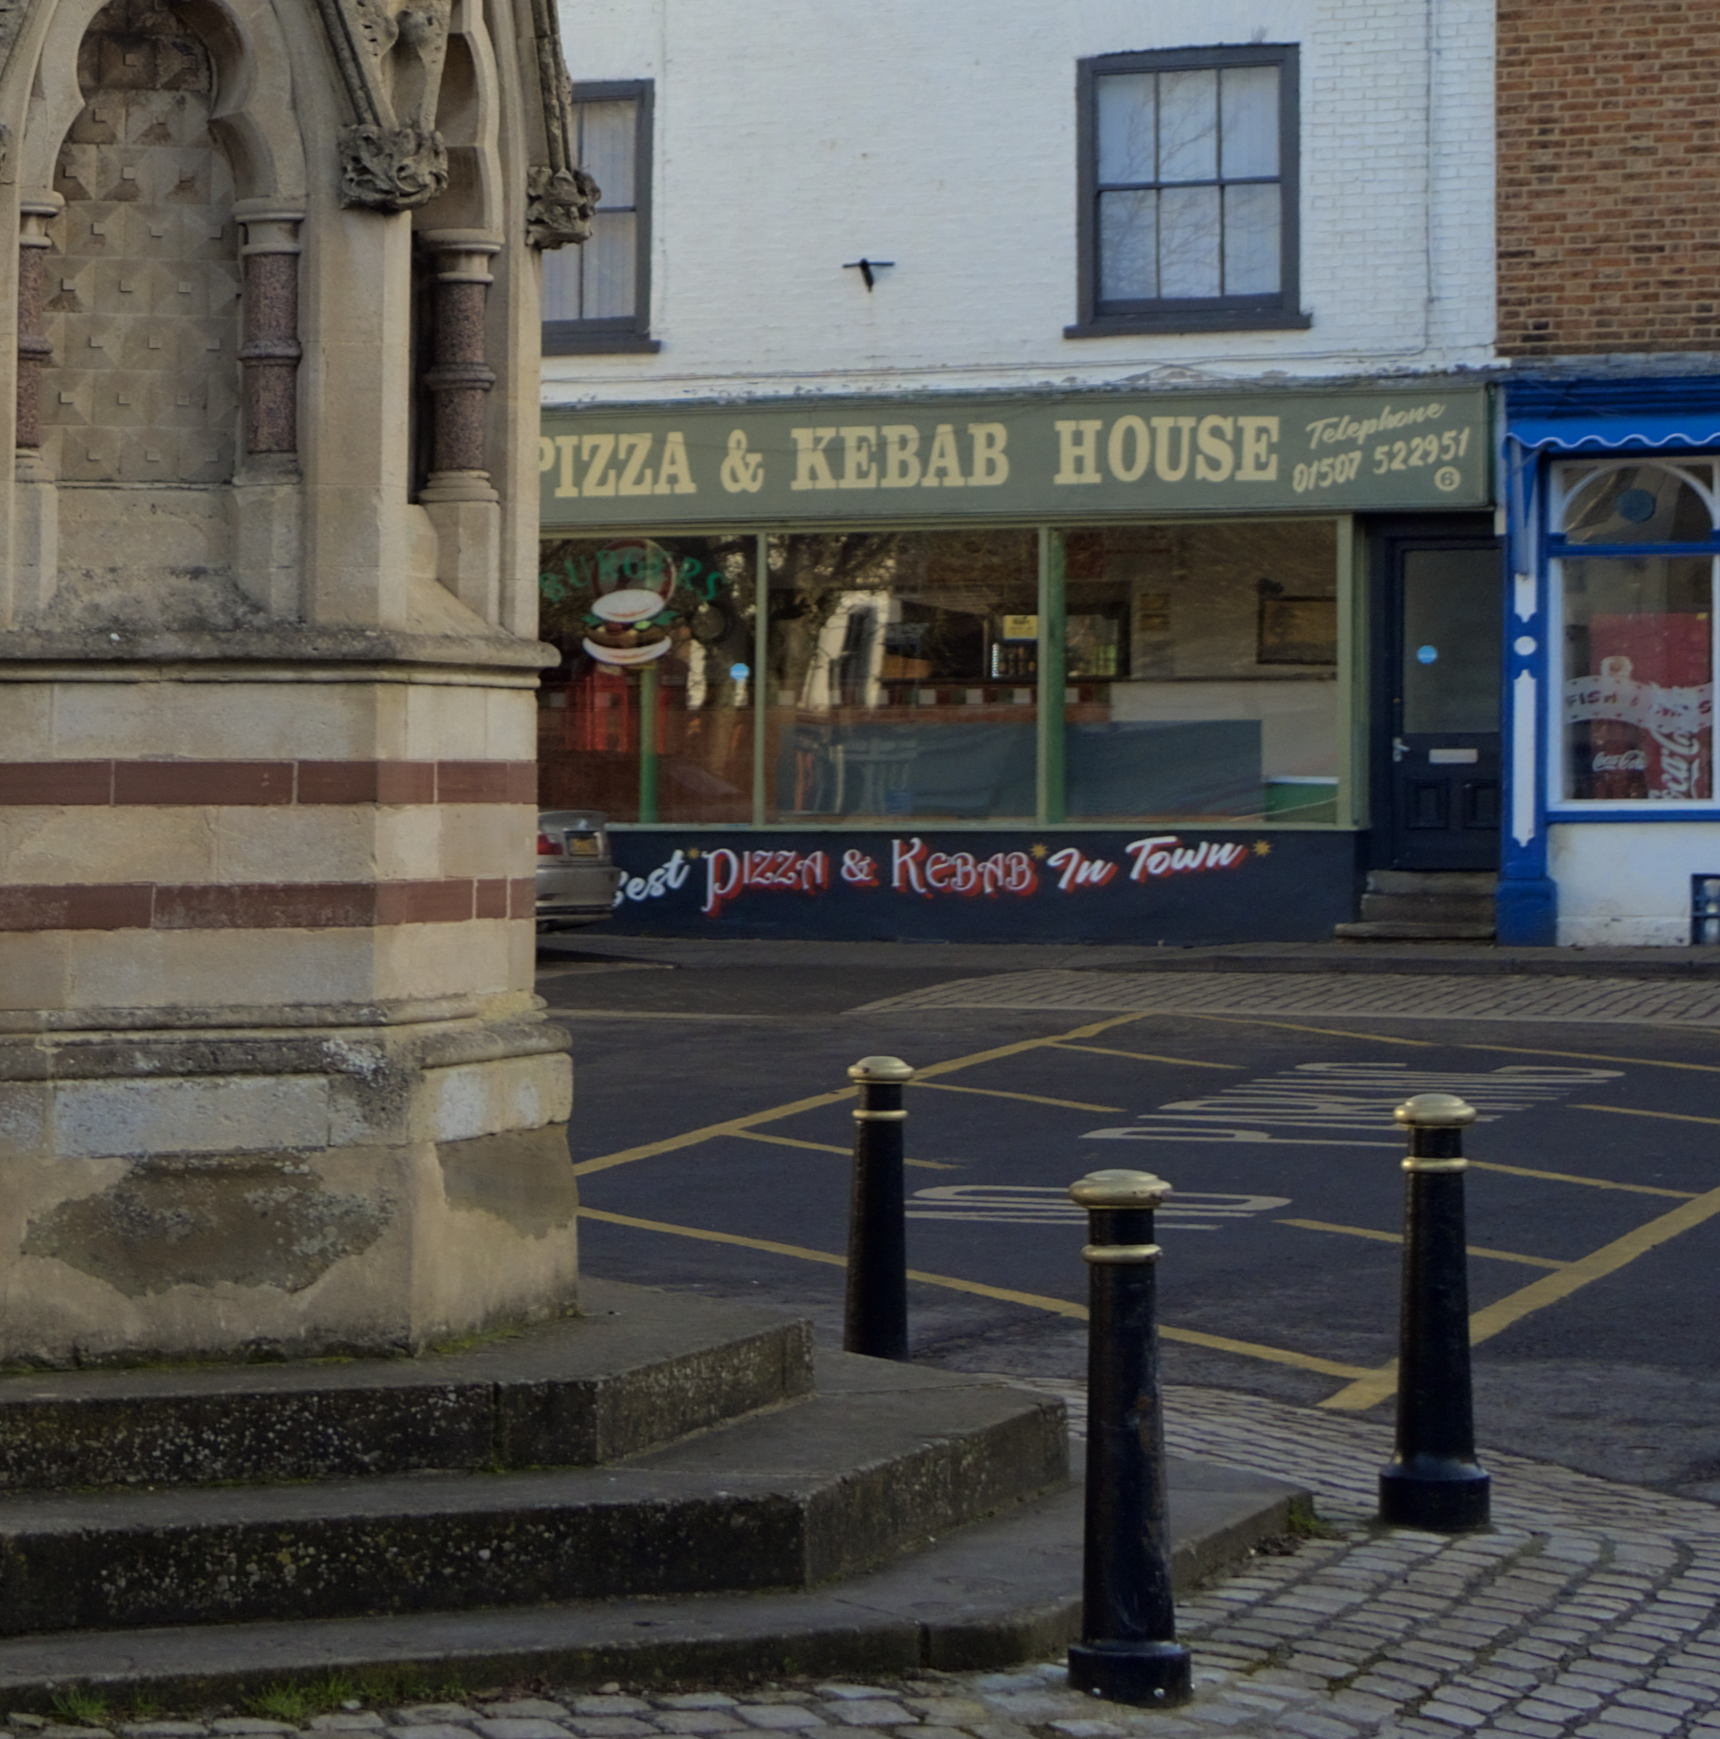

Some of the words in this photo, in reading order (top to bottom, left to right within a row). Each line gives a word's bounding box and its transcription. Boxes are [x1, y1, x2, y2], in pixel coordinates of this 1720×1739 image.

[1305, 402, 1446, 450] Telephone
[720, 428, 766, 493] &
[790, 422, 1010, 491] KEBAB
[1054, 413, 1280, 485] HOUSE
[1292, 449, 1363, 494] 01507
[1372, 425, 1471, 475] 522951
[1440, 470, 1455, 487] 6
[1565, 689, 1618, 708] FISH
[841, 849, 875, 884] &
[1048, 847, 1114, 893] In
[1125, 836, 1245, 882] Town
